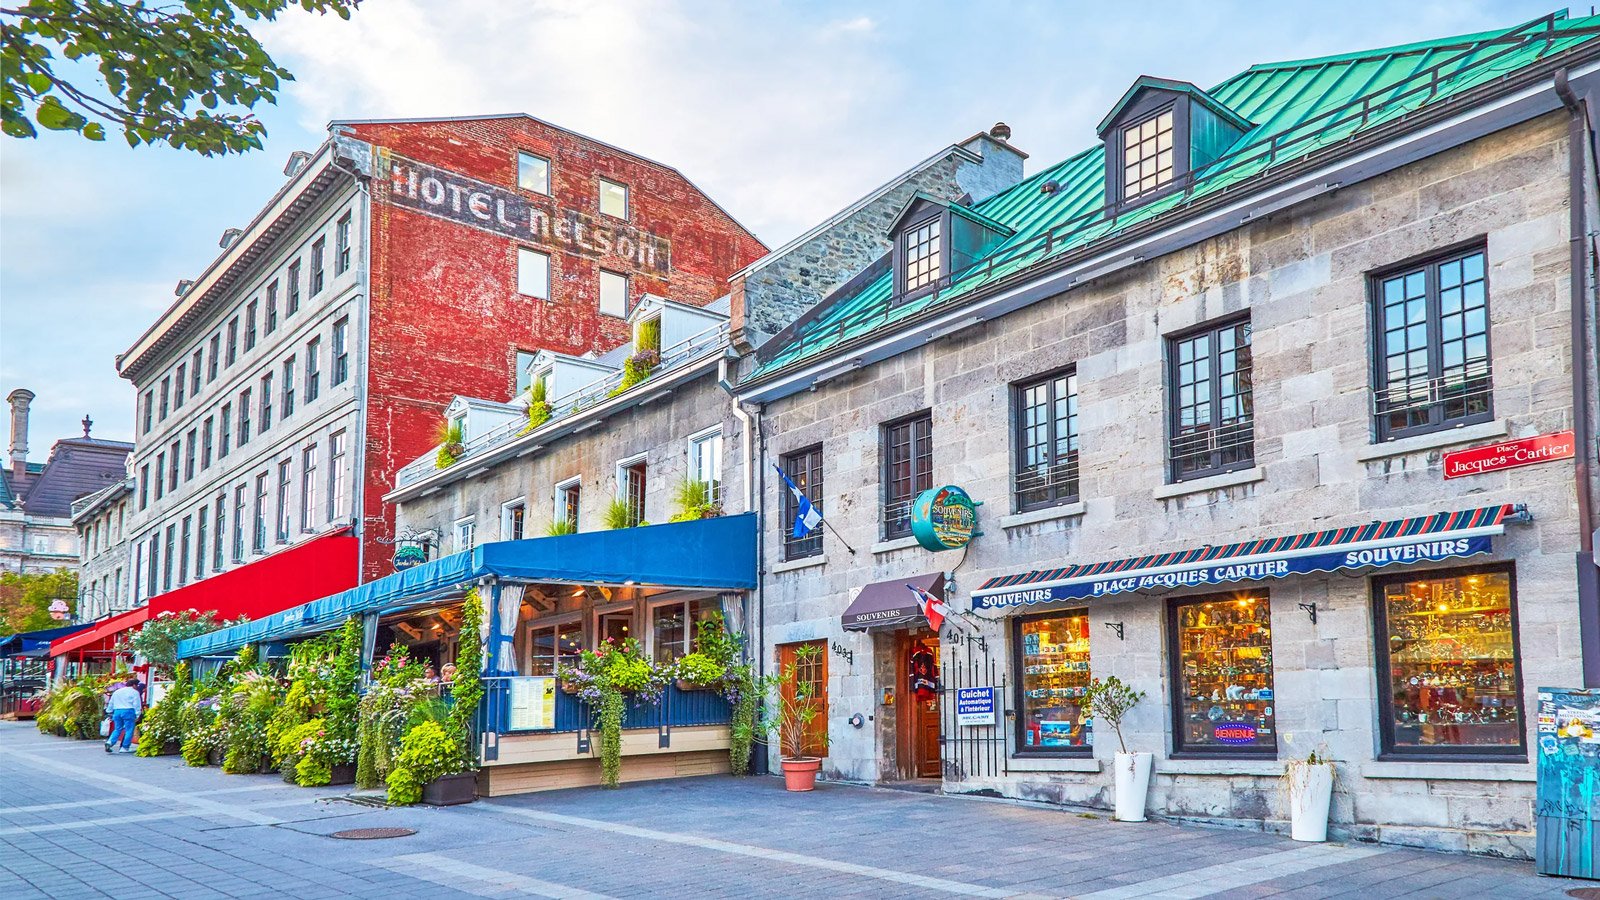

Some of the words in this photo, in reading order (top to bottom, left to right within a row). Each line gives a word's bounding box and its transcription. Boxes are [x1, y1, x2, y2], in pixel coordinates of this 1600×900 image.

[392, 160, 516, 229] HOTEL
[1496, 444, 1519, 453] Place
[1451, 443, 1570, 473] Jacques-Cartier
[932, 504, 974, 519] SOUVENIRS
[1345, 538, 1470, 566] SOUVENIRS
[982, 588, 1053, 608] SOUVENIRS
[1093, 576, 1137, 595] PLACE
[1138, 567, 1210, 588] JACQUES
[1213, 559, 1289, 580] CARTIER
[856, 609, 901, 622] SOUVENIRS
[946, 629, 965, 646] 401
[960, 689, 990, 699] Guichet
[959, 698, 992, 706] Automatique
[1215, 729, 1255, 739] BIENVENUE
